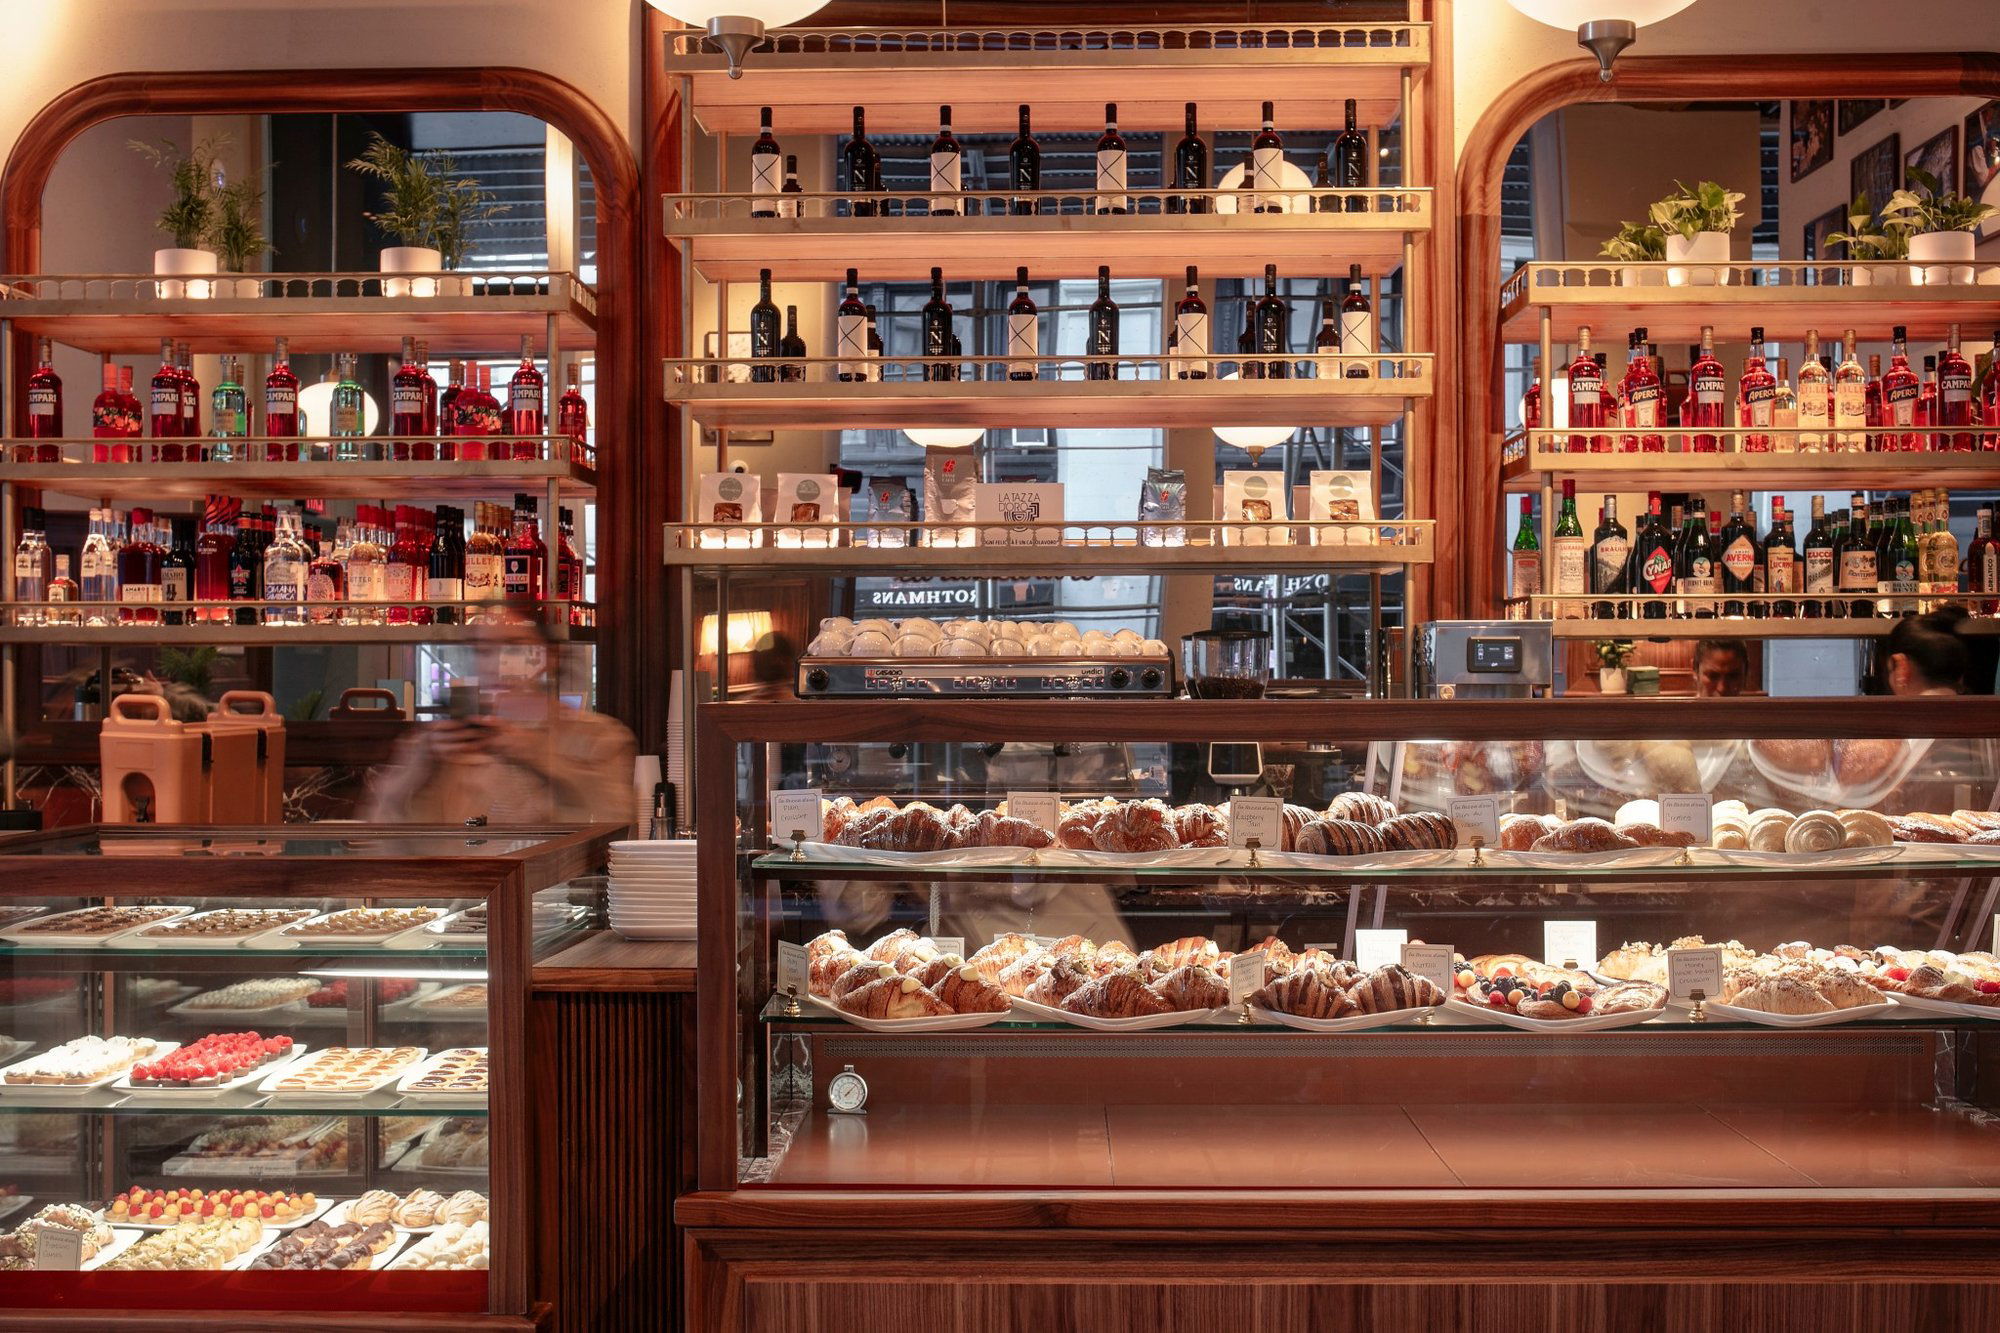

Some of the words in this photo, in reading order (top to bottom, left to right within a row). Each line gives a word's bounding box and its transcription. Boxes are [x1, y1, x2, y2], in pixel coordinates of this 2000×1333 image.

[1632, 388, 1658, 402] APEROL
[1749, 389, 1776, 402] APEROL
[1890, 387, 1918, 401] APEROL
[998, 493, 1010, 502] LA
[1012, 493, 1041, 502] TAZZA
[1726, 553, 1755, 562] AVERN
[1642, 557, 1673, 581] CYNAR
